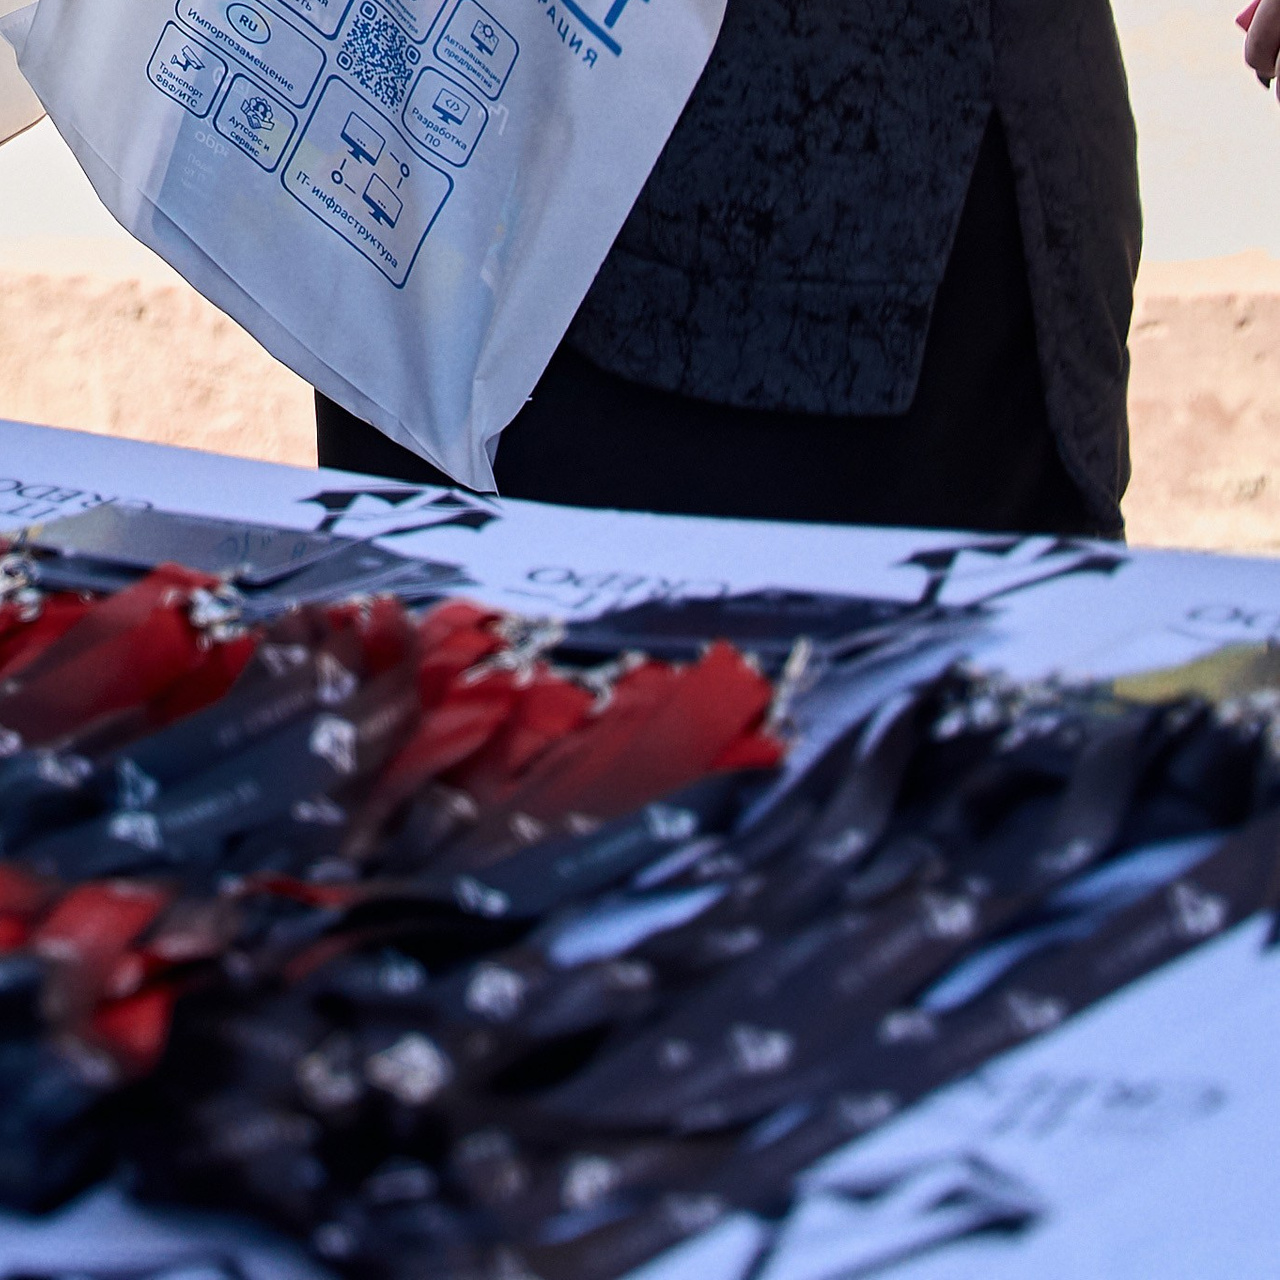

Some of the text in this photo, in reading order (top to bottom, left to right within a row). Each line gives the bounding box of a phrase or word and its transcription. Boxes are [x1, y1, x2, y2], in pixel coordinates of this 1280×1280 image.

[238, 14, 258, 33] RU
[187, 8, 294, 92] Импортозамещение
[155, 73, 198, 108] ФВФ/ИТС
[159, 60, 204, 100] Транспорт
[228, 115, 270, 152] Аутсорс и
[229, 130, 260, 158] сервис
[412, 107, 468, 152] Разработка
[424, 131, 441, 148] ПО
[311, 186, 399, 269] инфраструктура
